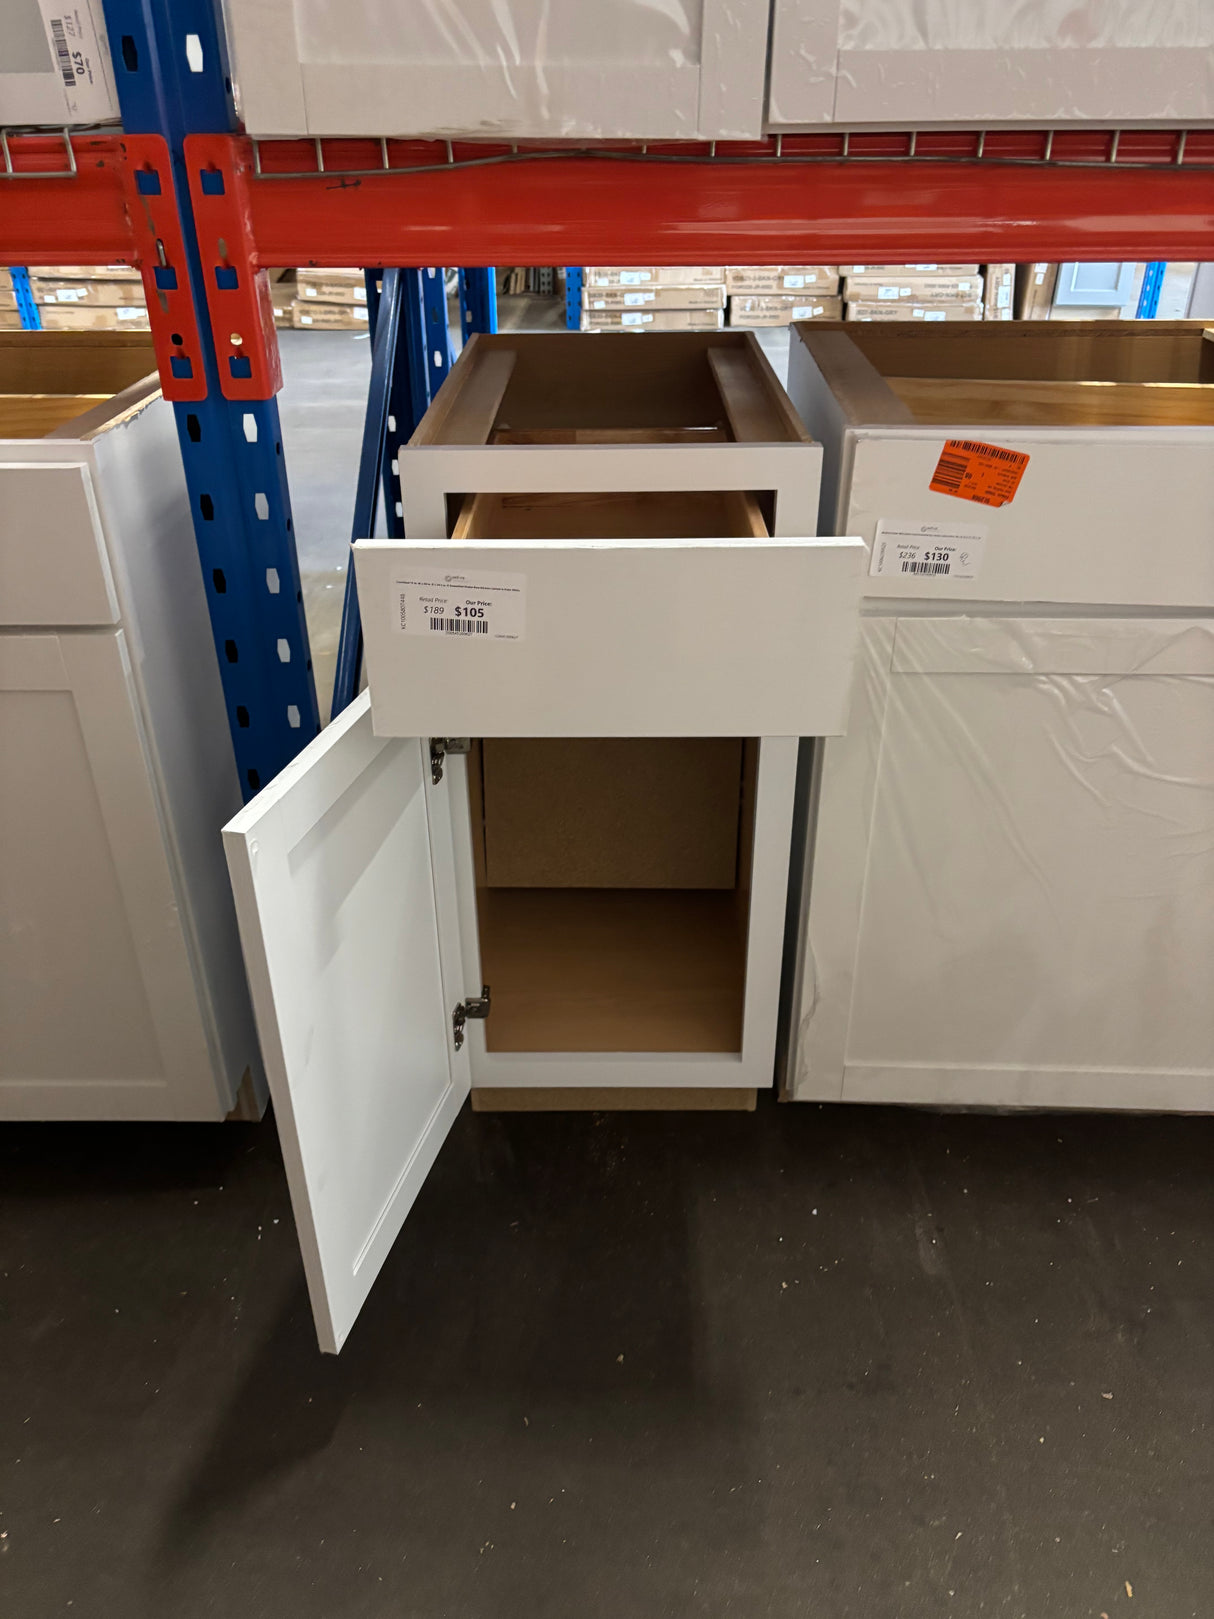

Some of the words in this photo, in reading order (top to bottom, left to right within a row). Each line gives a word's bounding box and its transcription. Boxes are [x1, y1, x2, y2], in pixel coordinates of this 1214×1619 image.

[72, 51, 85, 75] $70
[899, 551, 916, 559] $236
[924, 551, 949, 562] $130
[419, 596, 434, 604] Retail
[423, 605, 445, 615] $189
[454, 606, 485, 618] $105
